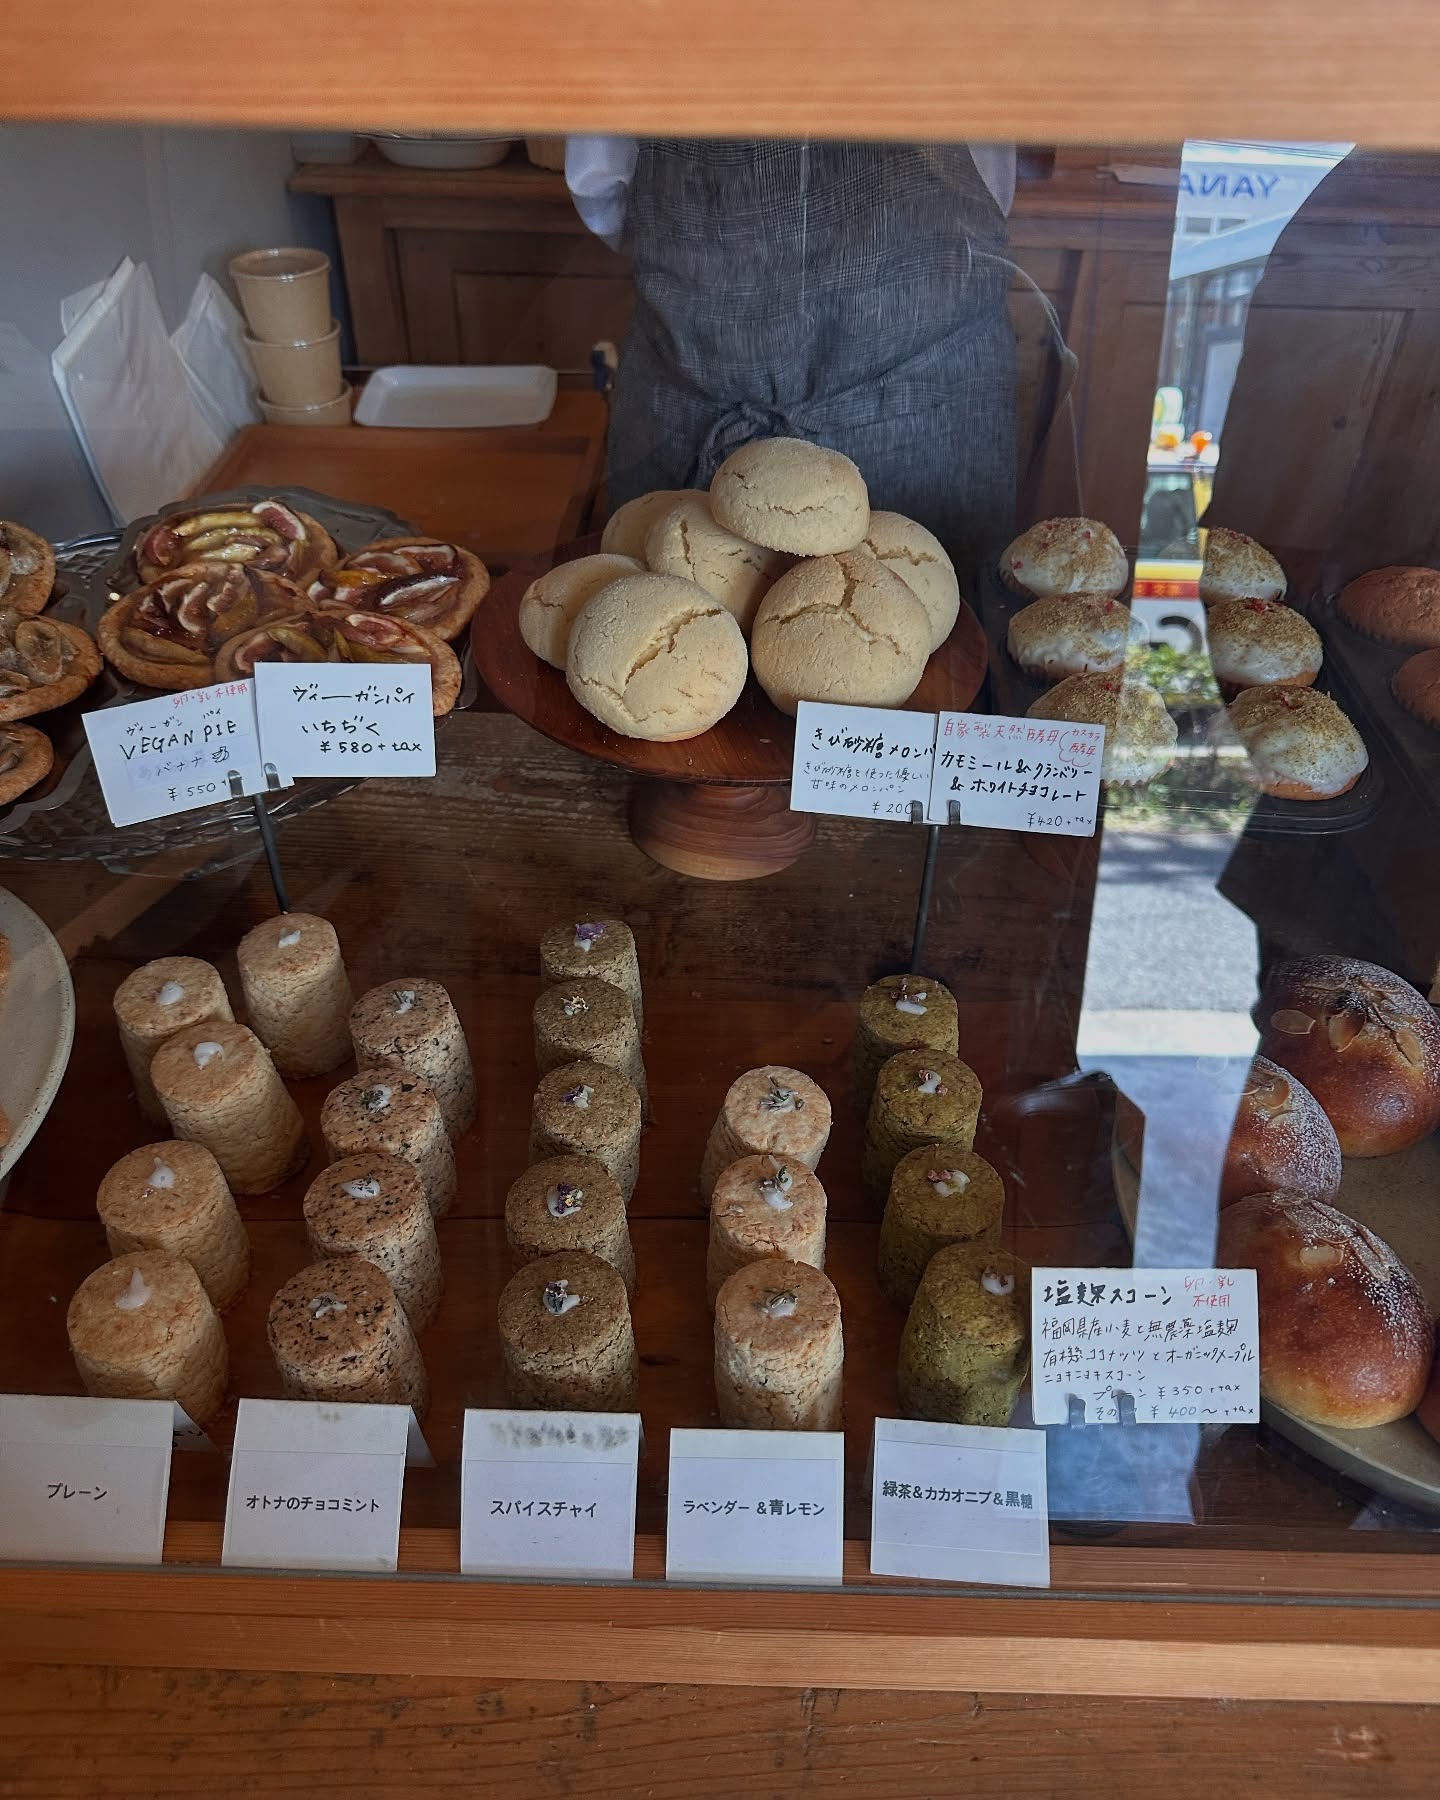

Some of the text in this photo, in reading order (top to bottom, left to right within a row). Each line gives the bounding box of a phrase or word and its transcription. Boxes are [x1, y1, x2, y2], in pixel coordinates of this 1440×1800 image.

[292, 683, 415, 704] ヴィーガンパイ
[302, 715, 381, 737] いちぢく
[120, 720, 237, 760] VEGAN PIE
[157, 756, 203, 777] バナナ
[1192, 1294, 1231, 1307] 不使用
[47, 1482, 108, 1501] プレーン
[246, 1494, 380, 1514] オトナのチョコミント
[490, 1499, 597, 1518] スパイスチャイ
